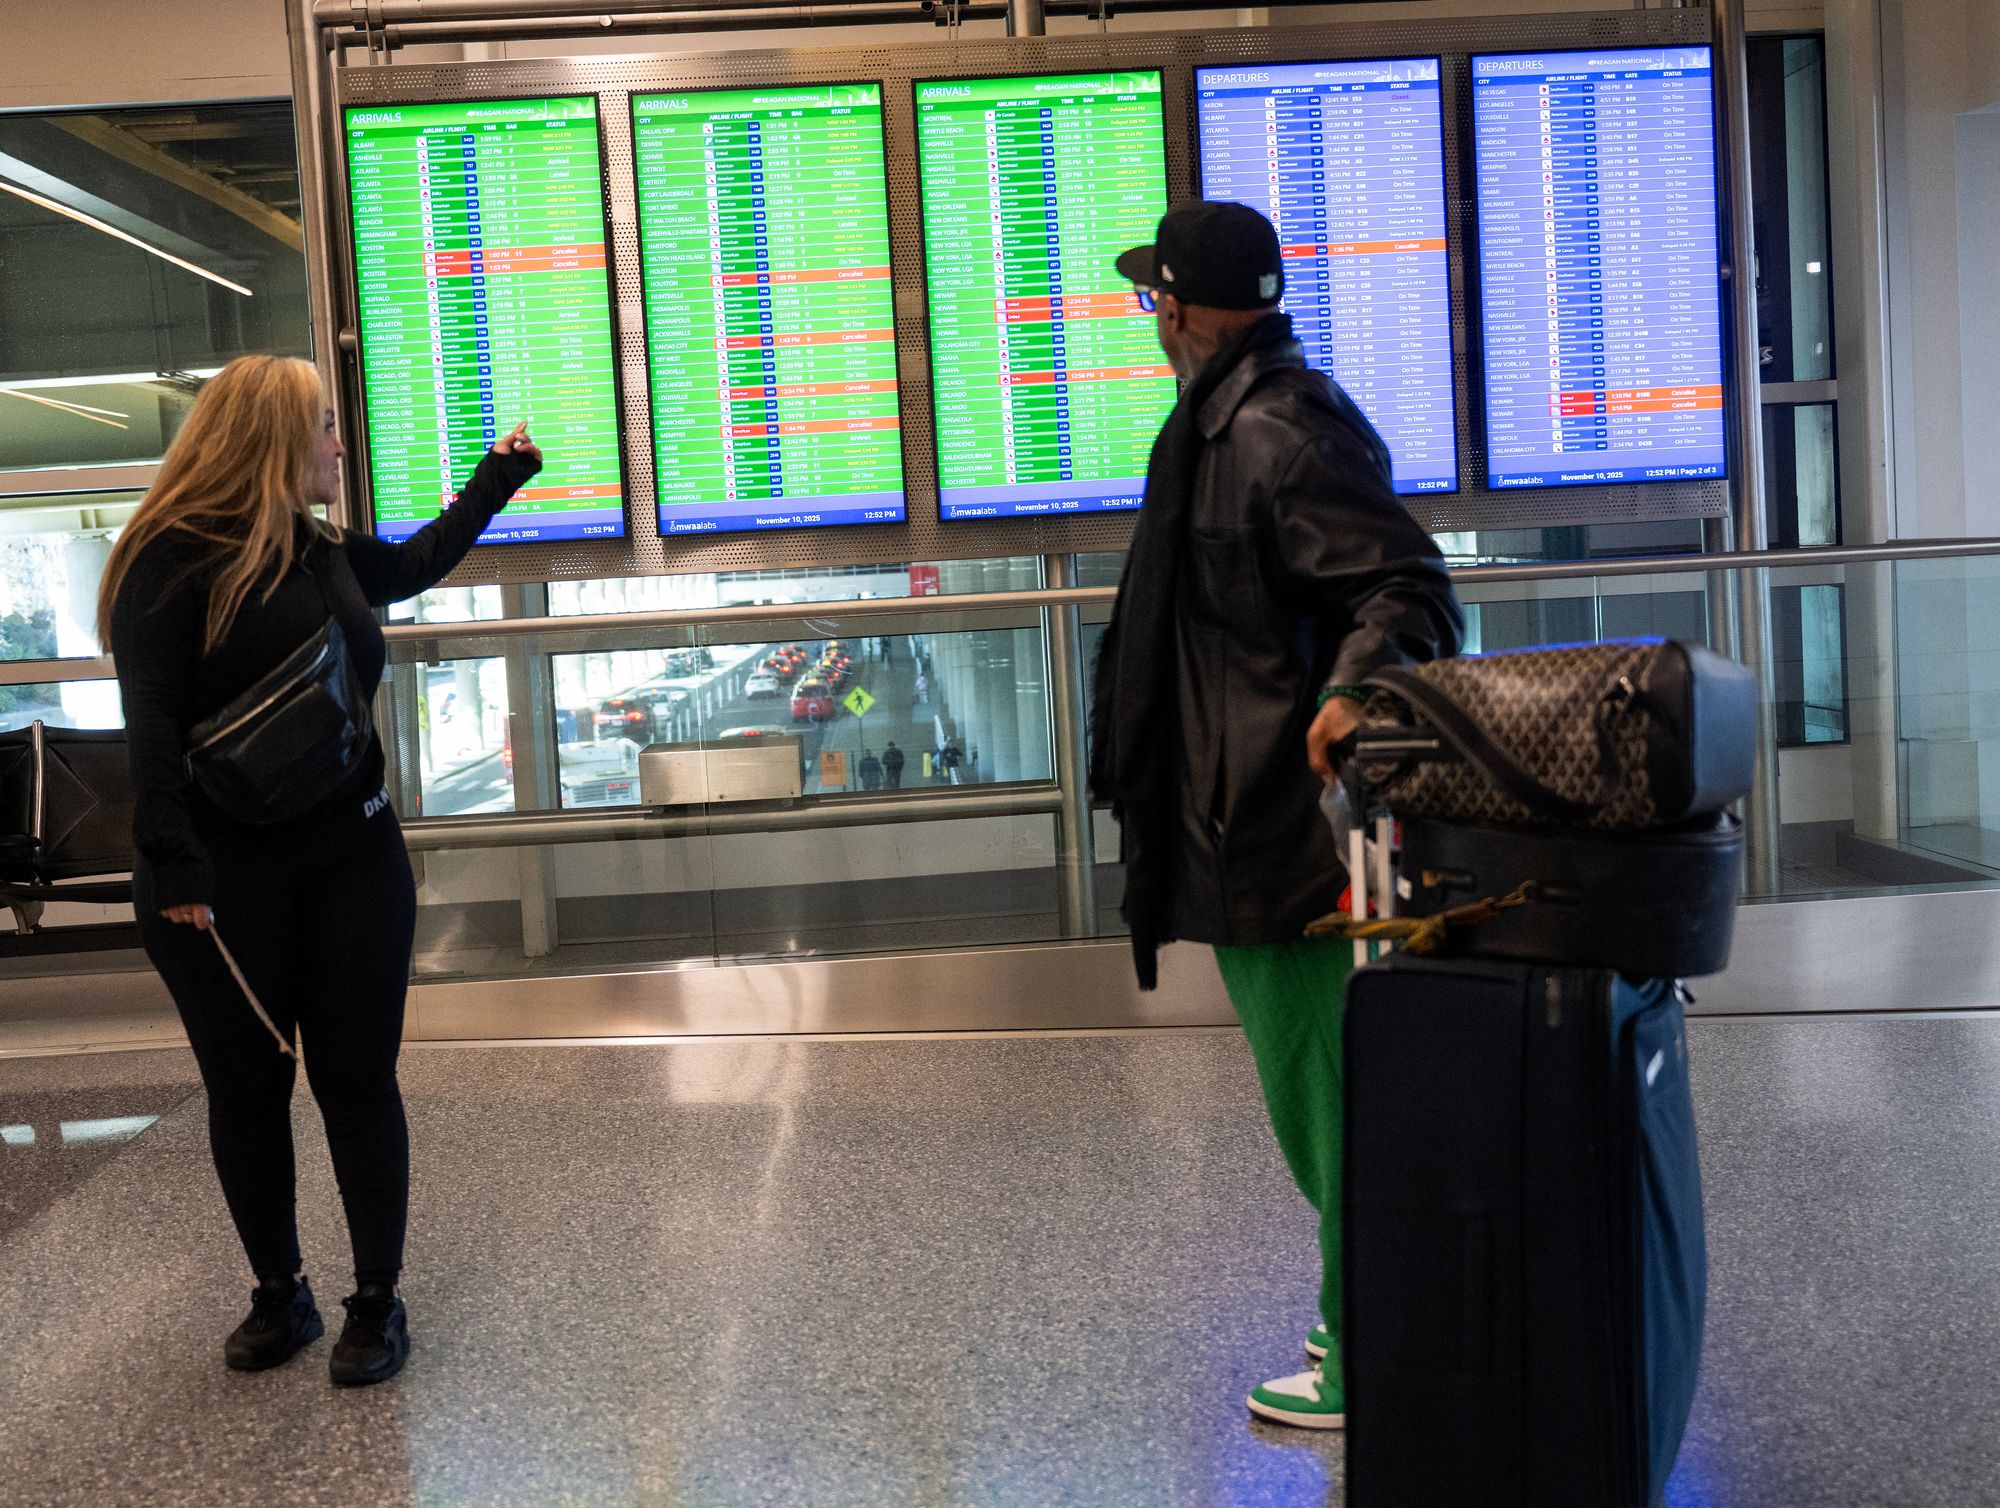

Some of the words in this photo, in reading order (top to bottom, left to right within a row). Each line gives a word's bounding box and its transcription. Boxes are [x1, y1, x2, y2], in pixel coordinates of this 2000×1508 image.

[1478, 60, 1544, 72] DEPARTURES
[1203, 72, 1270, 85] DEPARTURES
[921, 86, 971, 98] ARRIVALS
[638, 99, 689, 111] ARRIVALS
[351, 112, 402, 125] ARRIVALS
[366, 321, 403, 329] CHARLESTON
[1504, 476, 1543, 486] mwaalabs
[1561, 473, 1595, 481] November
[1680, 468, 1697, 476] Page
[956, 506, 997, 516] mwaalabs
[1015, 503, 1050, 511] November
[1050, 502, 1061, 510] 10,
[676, 521, 717, 531] mwaalabs
[756, 516, 791, 525] November
[792, 516, 802, 524] 10,
[477, 532, 509, 540] ovember
[510, 531, 521, 539] 10,
[521, 530, 539, 538] 2025
[583, 526, 602, 534] 12:52
